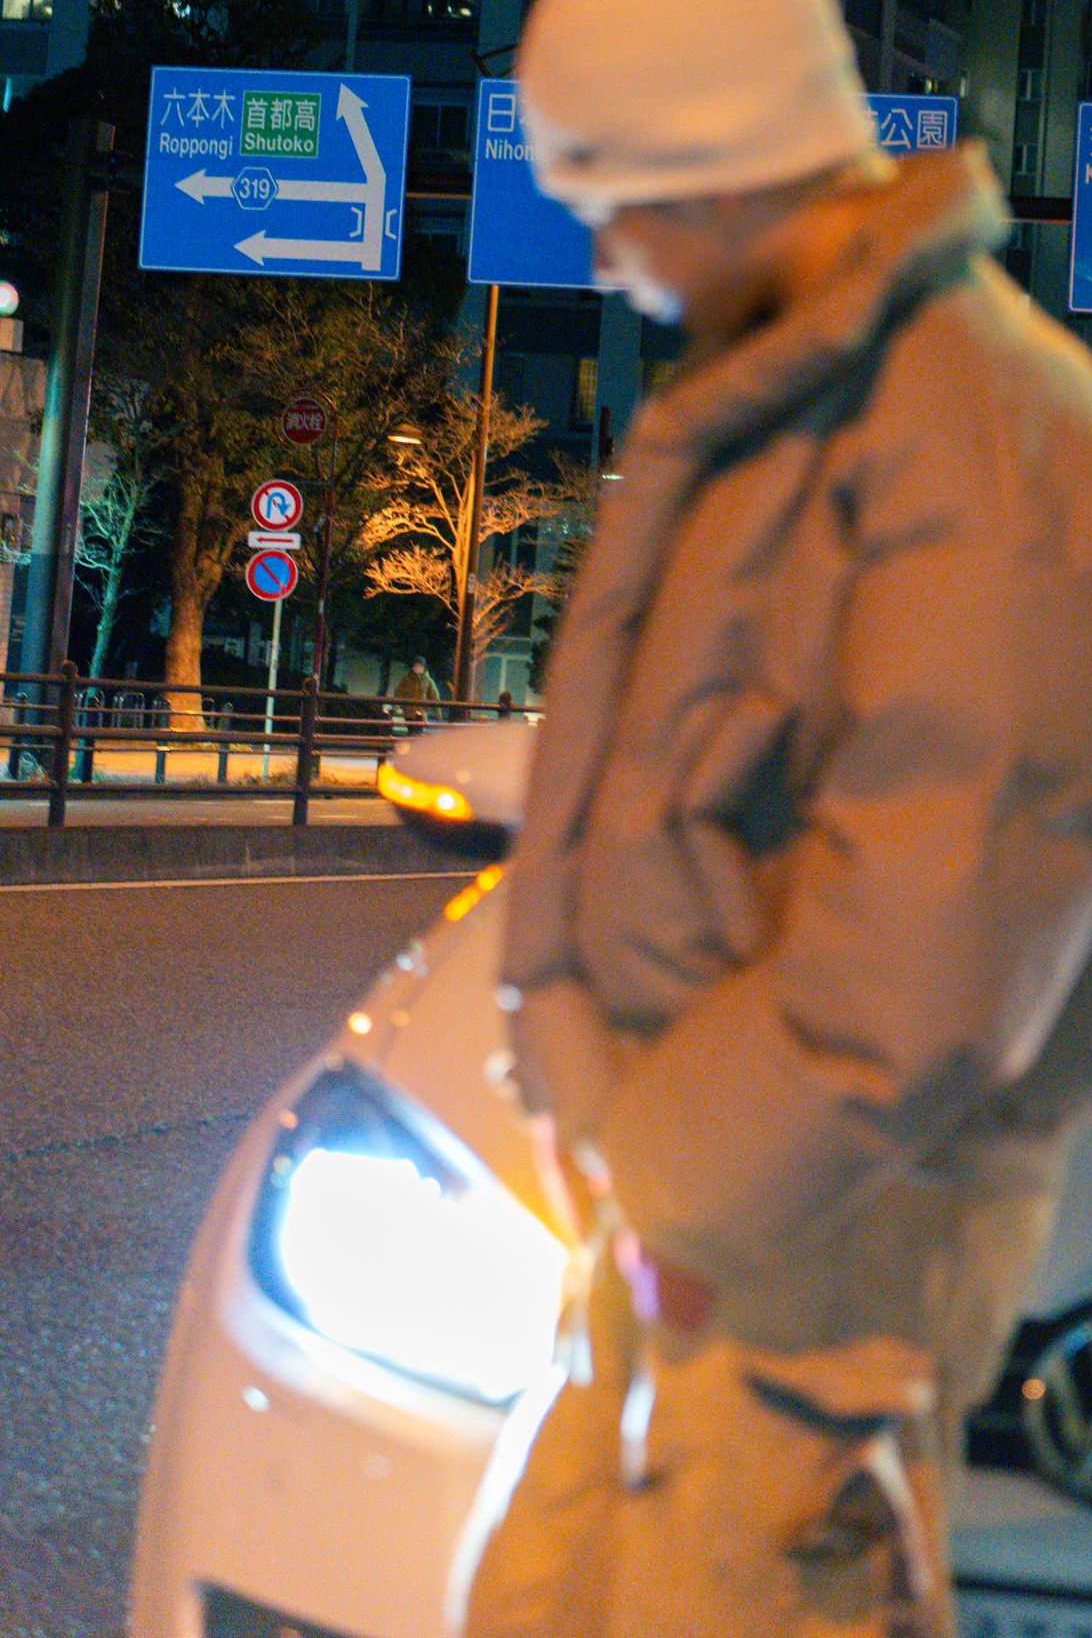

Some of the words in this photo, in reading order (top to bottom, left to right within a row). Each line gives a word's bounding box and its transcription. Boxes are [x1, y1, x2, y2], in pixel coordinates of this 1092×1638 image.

[160, 87, 235, 128] 六本木
[246, 97, 317, 131] 首都高
[866, 106, 948, 149] 公園
[159, 132, 233, 159] Roppongi
[244, 132, 314, 154] Shutoko
[238, 177, 270, 200] 319
